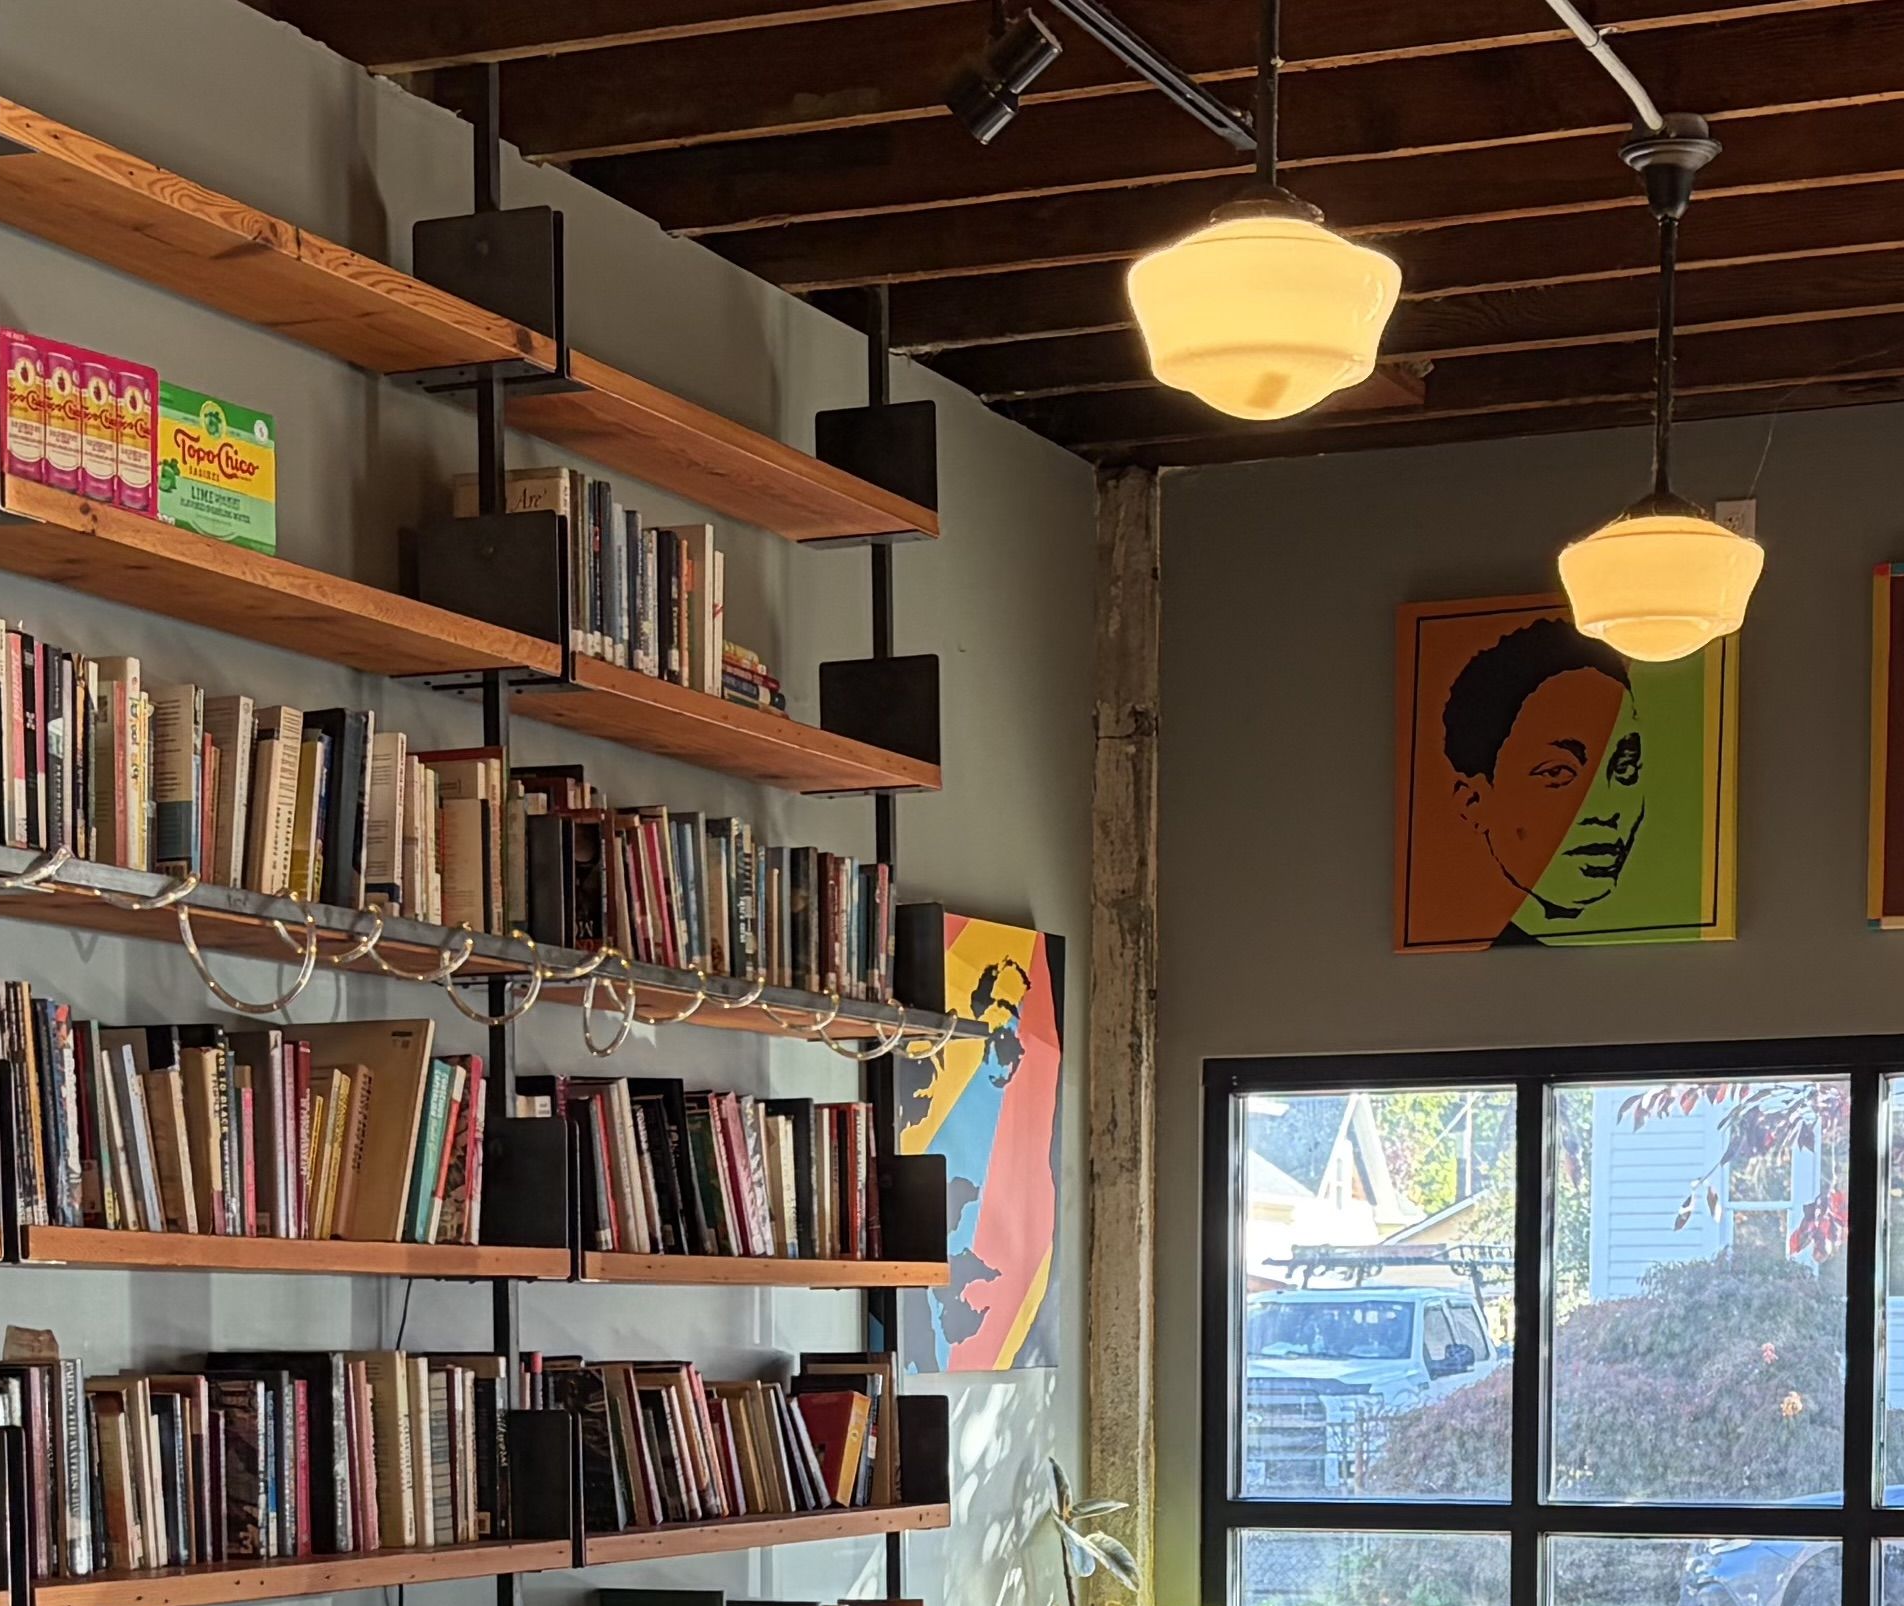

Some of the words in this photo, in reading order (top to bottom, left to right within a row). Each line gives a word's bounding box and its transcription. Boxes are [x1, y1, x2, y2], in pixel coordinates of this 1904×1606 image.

[174, 427, 219, 471] Topo
[217, 441, 259, 480] Chico
[191, 484, 214, 501] LIME
[67, 1413, 77, 1436] THE
[68, 1437, 78, 1490] WATERS
